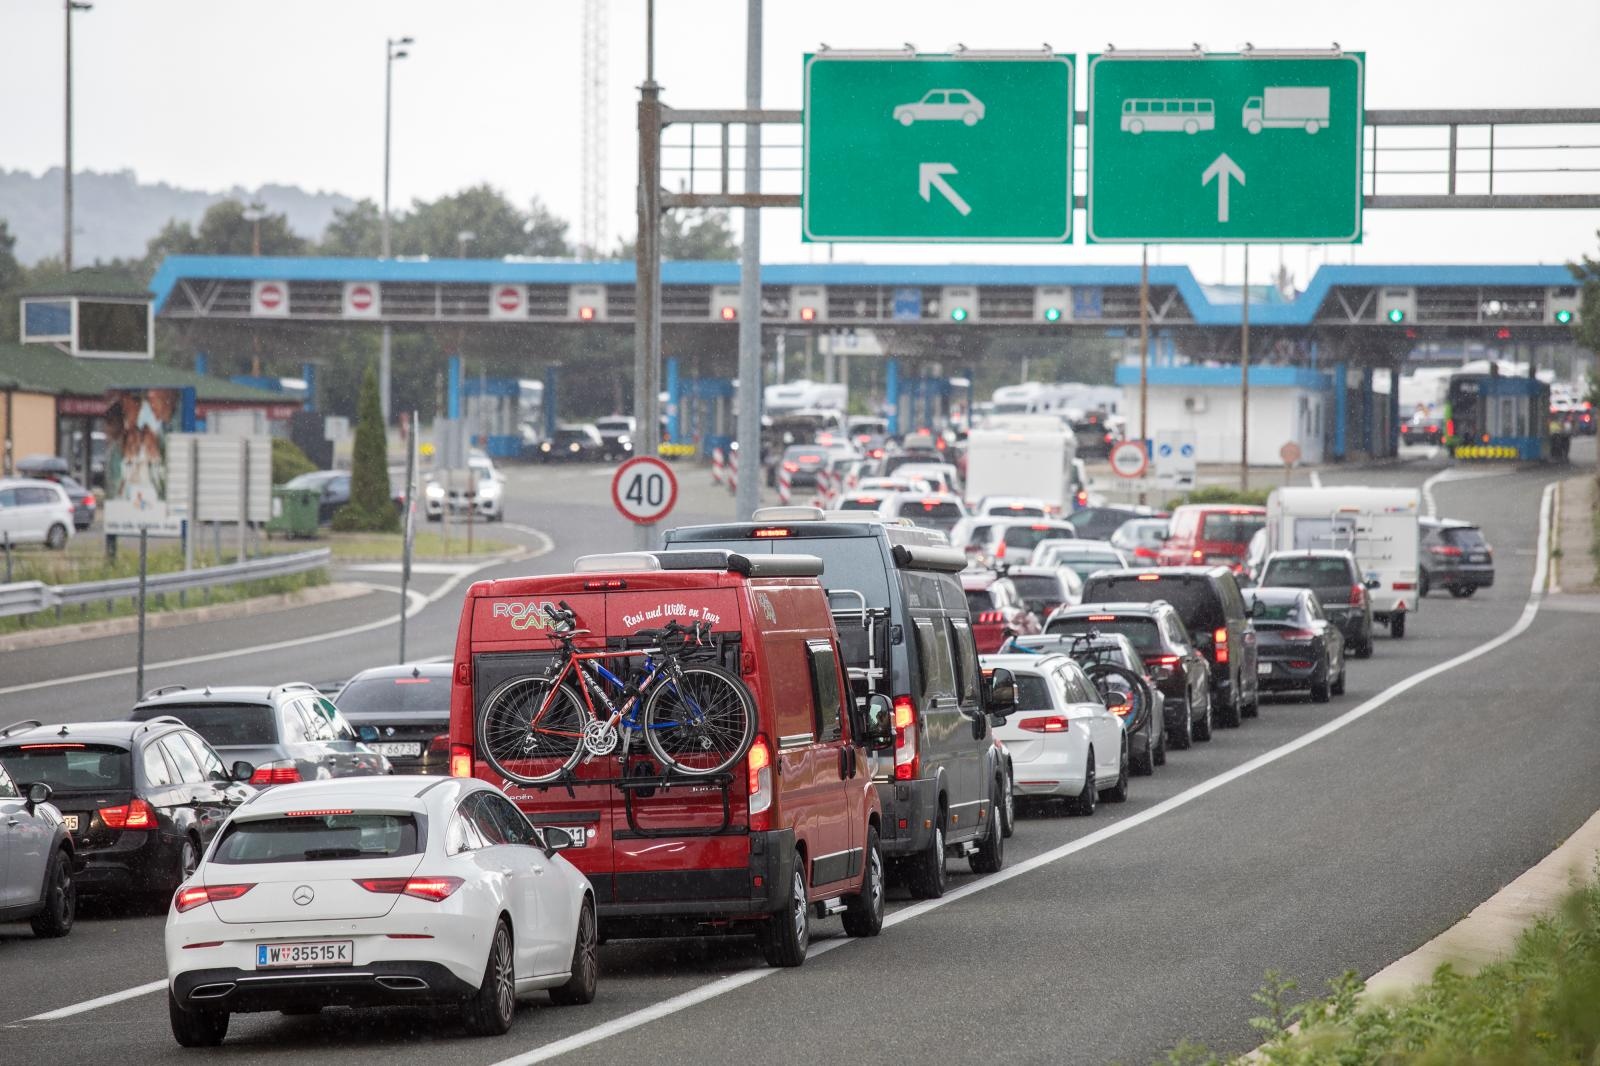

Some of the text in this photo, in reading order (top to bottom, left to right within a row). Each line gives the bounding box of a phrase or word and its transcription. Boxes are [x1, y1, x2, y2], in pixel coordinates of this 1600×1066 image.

[626, 474, 663, 506] 40
[493, 601, 556, 617] ROAD
[623, 603, 721, 627] Rosi und Willi on Tour
